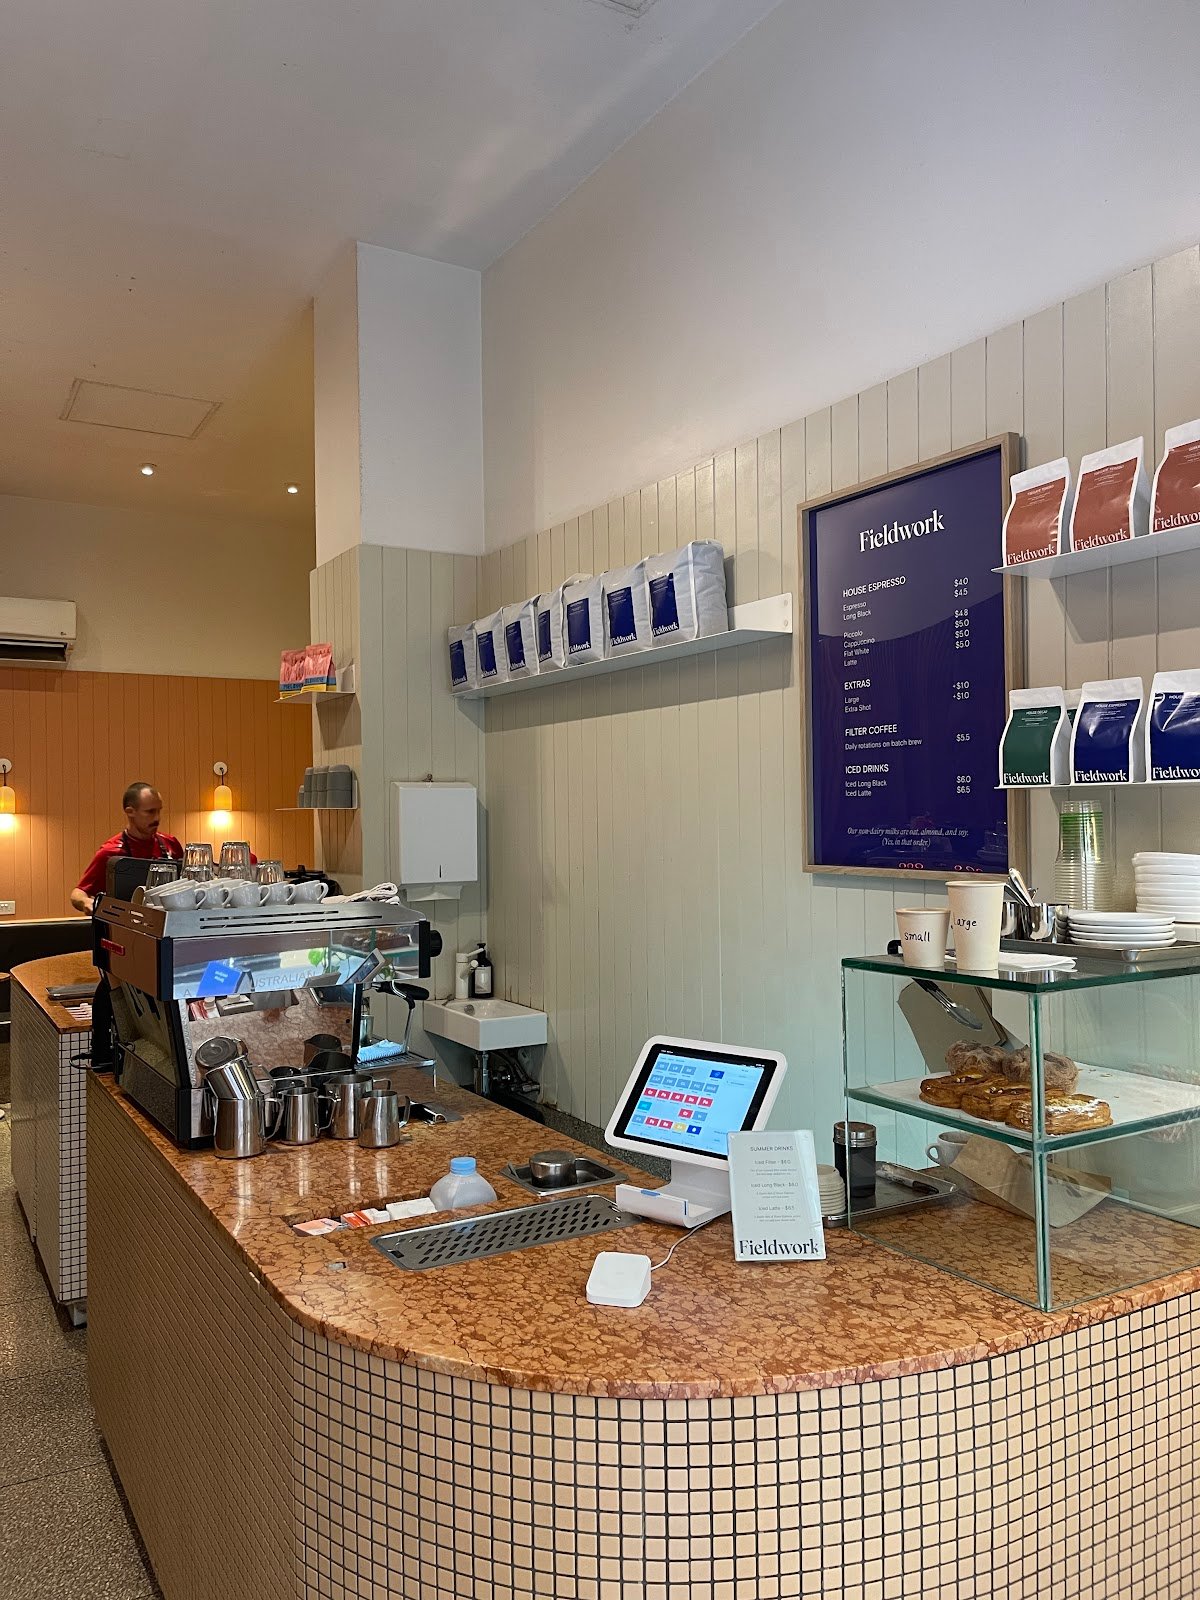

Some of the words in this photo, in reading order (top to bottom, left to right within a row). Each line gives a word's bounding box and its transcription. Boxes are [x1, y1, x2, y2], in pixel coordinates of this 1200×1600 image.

[859, 509, 945, 552] Fieldwork
[1074, 528, 1128, 550] Fieldwork
[1007, 544, 1055, 564] Fieldwork
[843, 585, 867, 598] HOUSE
[868, 576, 906, 592] ESPRESSO
[843, 601, 867, 612] Espresso
[843, 612, 856, 621] Long
[857, 609, 872, 618] Black
[843, 630, 863, 638] Piccolo
[843, 637, 876, 649] Cappuccino
[843, 649, 854, 657] Flat
[854, 647, 870, 656] White
[843, 659, 858, 667] Latte
[844, 679, 871, 690] EXTRAS
[844, 696, 860, 704] Large
[844, 705, 858, 713] Extra
[858, 704, 872, 712] Shot
[845, 726, 868, 737] FILTER
[868, 724, 898, 734] COFFEE
[845, 743, 857, 751] Daily
[858, 741, 882, 749] rotations
[891, 739, 907, 747] batch
[845, 765, 861, 774] ICED
[862, 764, 889, 773] DRINKS
[1152, 766, 1200, 779] Fieldwo
[1003, 772, 1050, 784] Fieldwork
[1074, 769, 1128, 782] Fieldwork
[845, 780, 857, 788] Iced
[857, 780, 871, 788] Long
[872, 779, 887, 787] Black
[845, 789, 857, 797] Iced
[857, 789, 872, 797] Latte
[904, 931, 930, 942] small
[739, 1239, 819, 1256] Fieldwork
